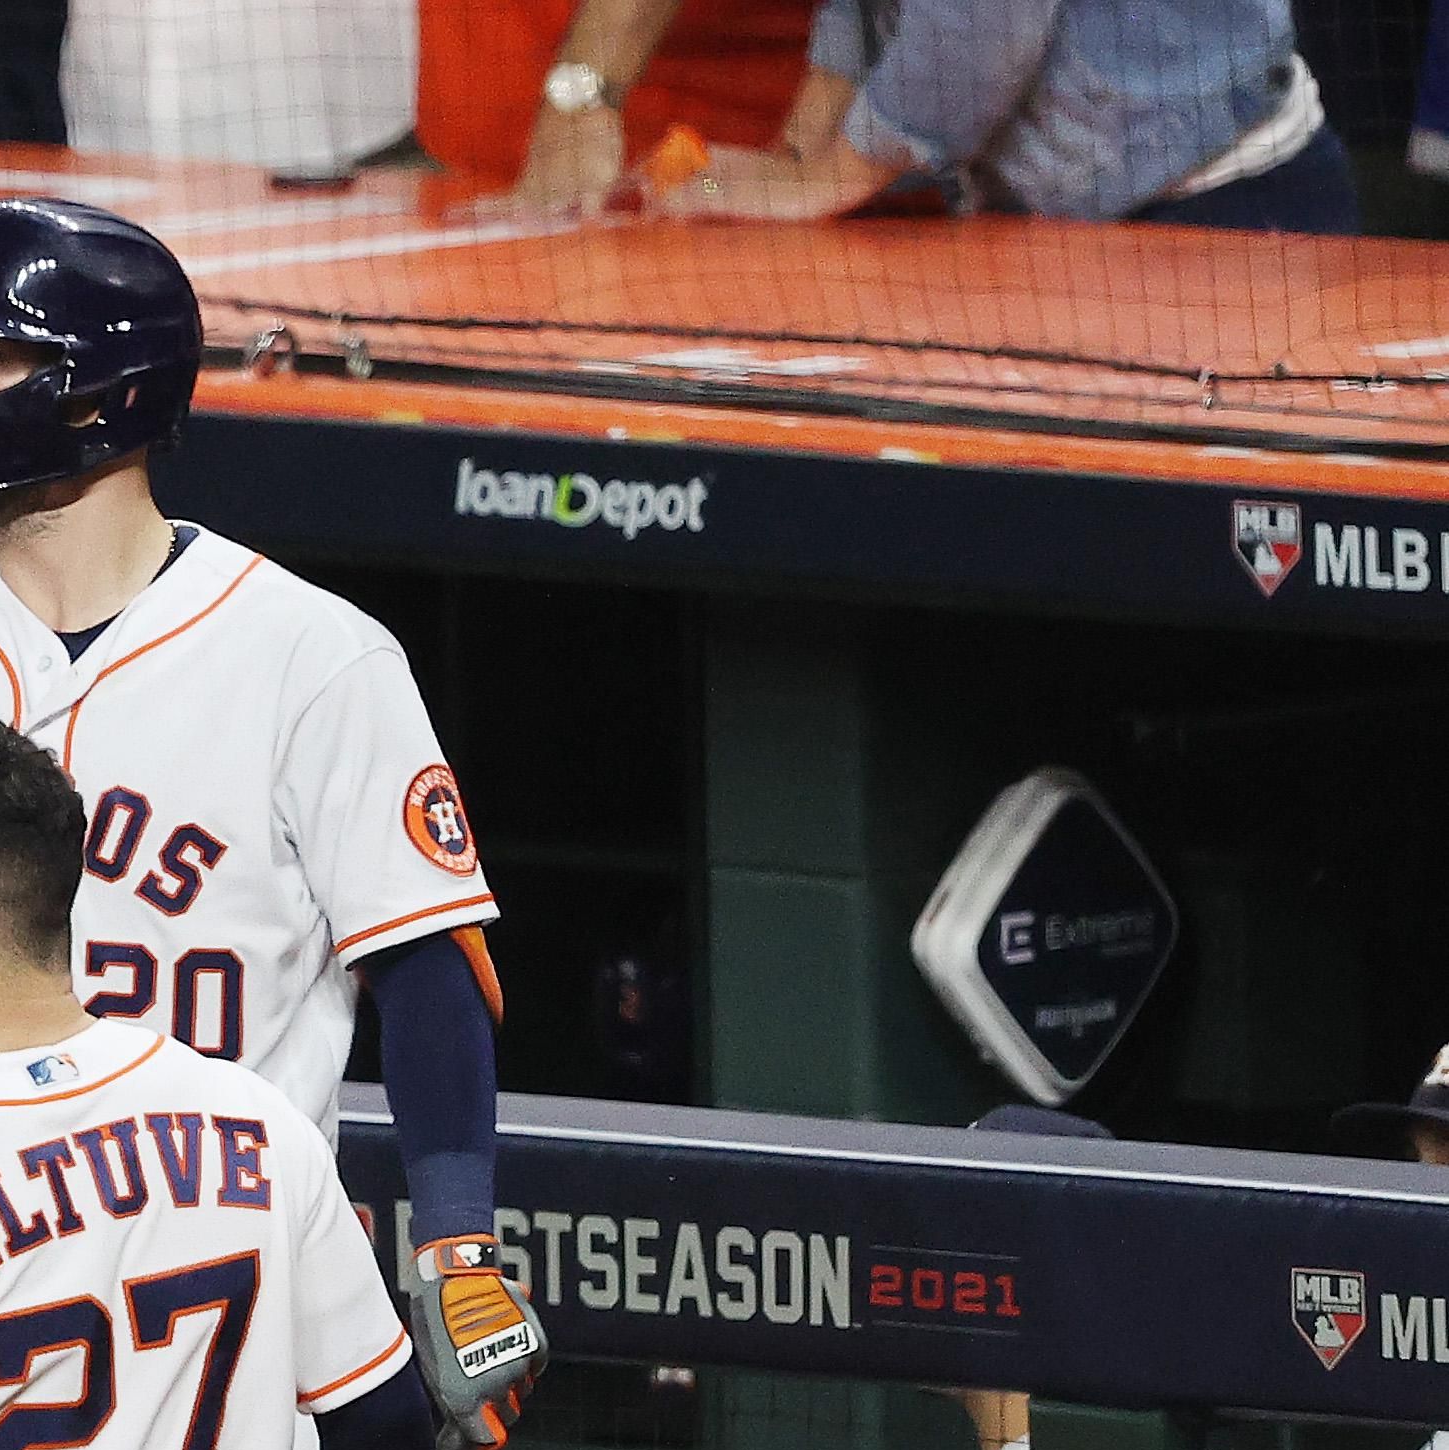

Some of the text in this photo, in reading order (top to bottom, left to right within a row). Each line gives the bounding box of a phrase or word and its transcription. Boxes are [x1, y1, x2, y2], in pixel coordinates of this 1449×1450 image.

[455, 457, 709, 540] loanDepot
[1314, 520, 1433, 593] MLB
[84, 940, 245, 1060] 20
[394, 1200, 1022, 1328] STSEASON 2021
[1296, 1273, 1361, 1304] MLB
